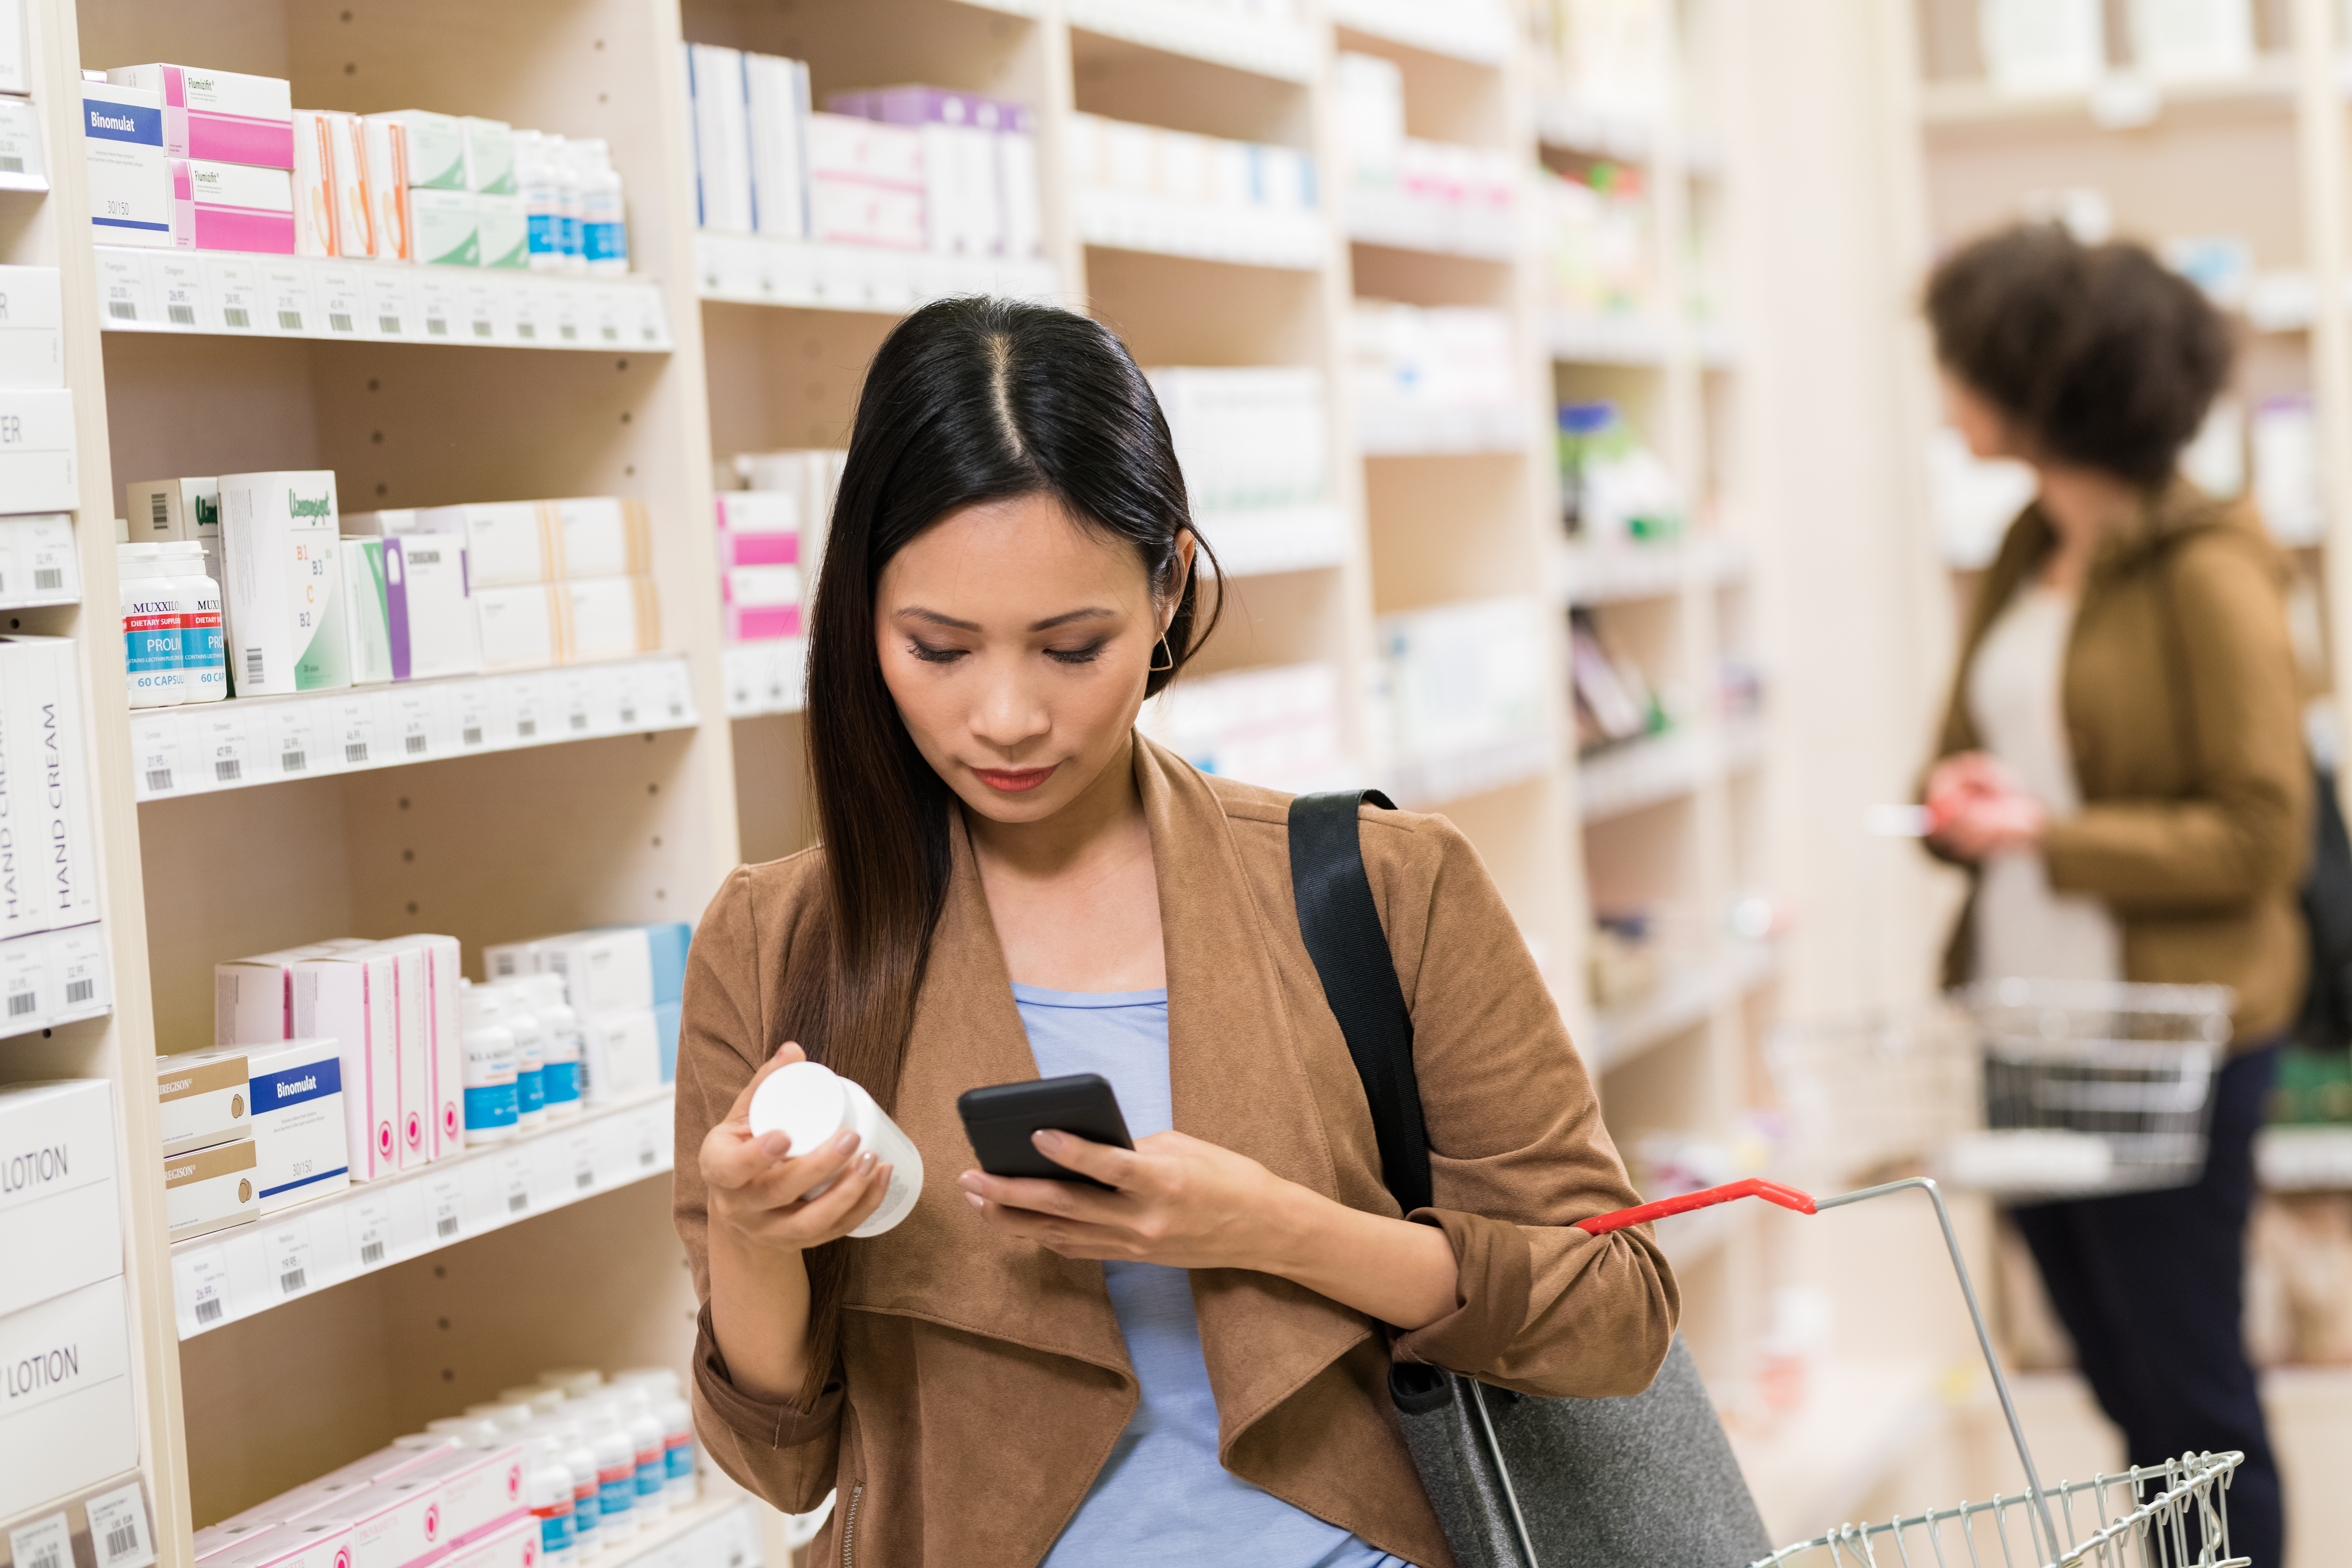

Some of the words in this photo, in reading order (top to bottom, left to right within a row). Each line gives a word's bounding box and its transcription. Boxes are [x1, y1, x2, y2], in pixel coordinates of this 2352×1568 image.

[91, 111, 135, 132] Binomulat
[107, 201, 129, 215] 30/150
[0, 415, 21, 443] ER
[297, 544, 308, 560] B1
[312, 560, 323, 575] B3
[307, 585, 314, 603] C
[133, 601, 179, 613] MUXXILO
[131, 619, 160, 627] DIETARY
[299, 611, 311, 627] B2
[138, 678, 151, 687] 60
[201, 674, 212, 683] 60
[42, 703, 62, 809] CREAM
[51, 818, 71, 909] HAND
[0, 827, 18, 919] HAND
[277, 1075, 317, 1098] Binomulat
[2, 1143, 67, 1194] LOTION
[293, 1159, 312, 1176] 30/150
[7, 1343, 79, 1399] LOTION
